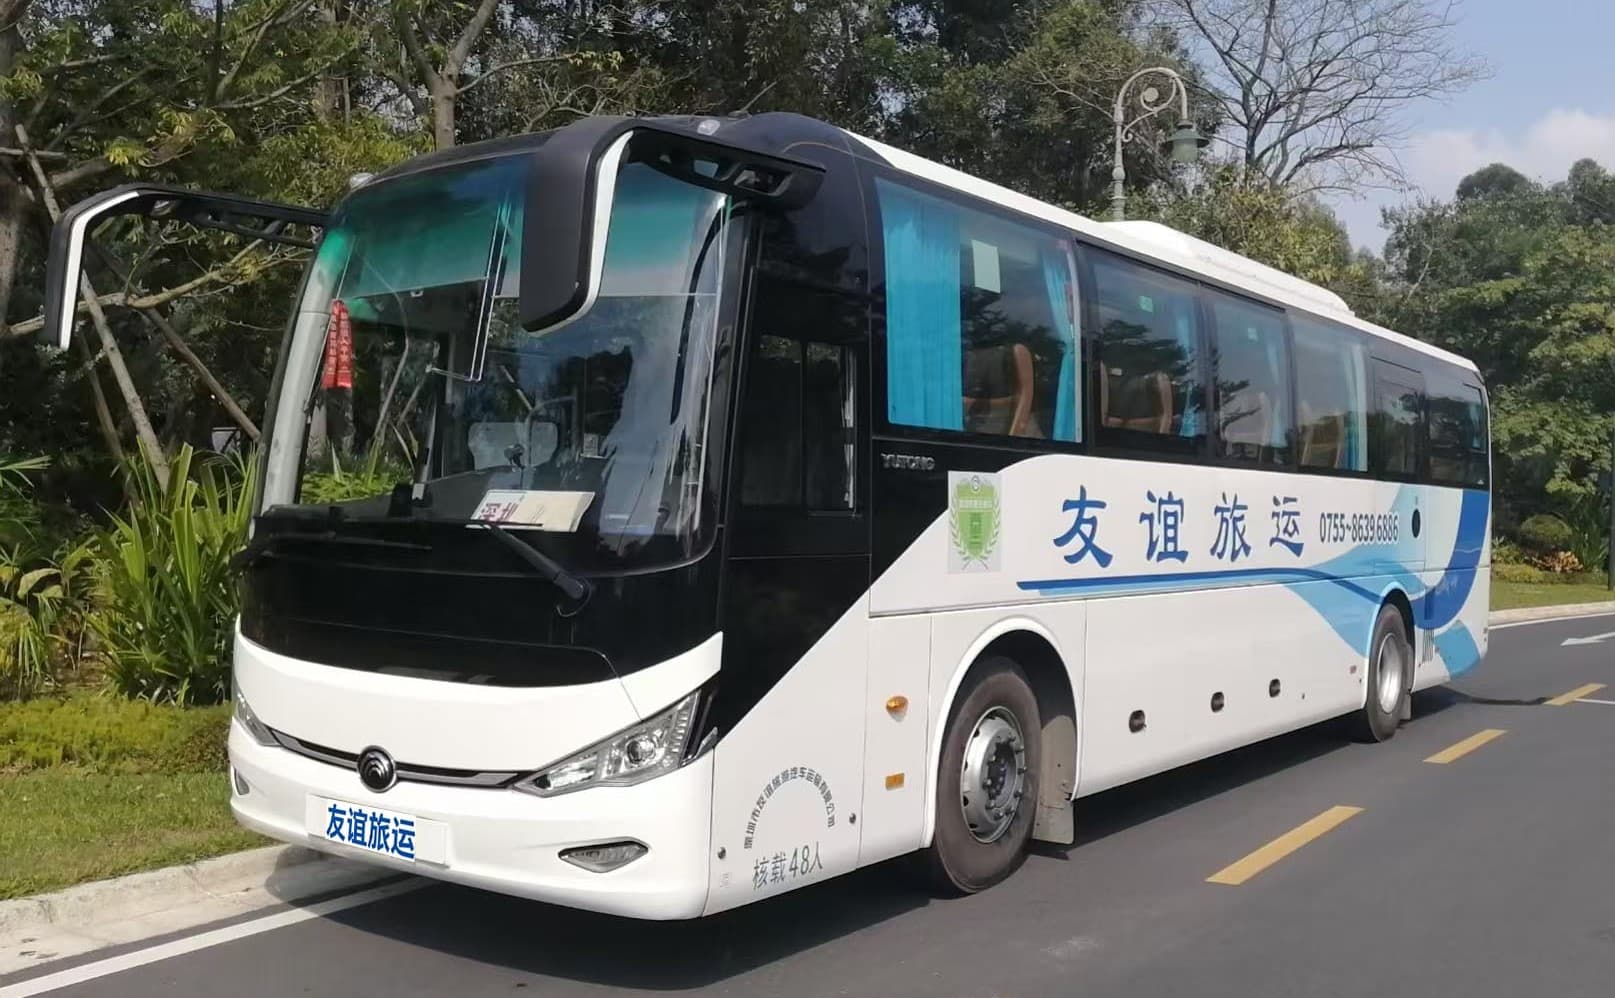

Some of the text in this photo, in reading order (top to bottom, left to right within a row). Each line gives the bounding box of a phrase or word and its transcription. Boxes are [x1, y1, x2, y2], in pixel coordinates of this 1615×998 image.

[1053, 485, 1305, 569] 友谊旅运
[752, 840, 823, 891] 核载48人
